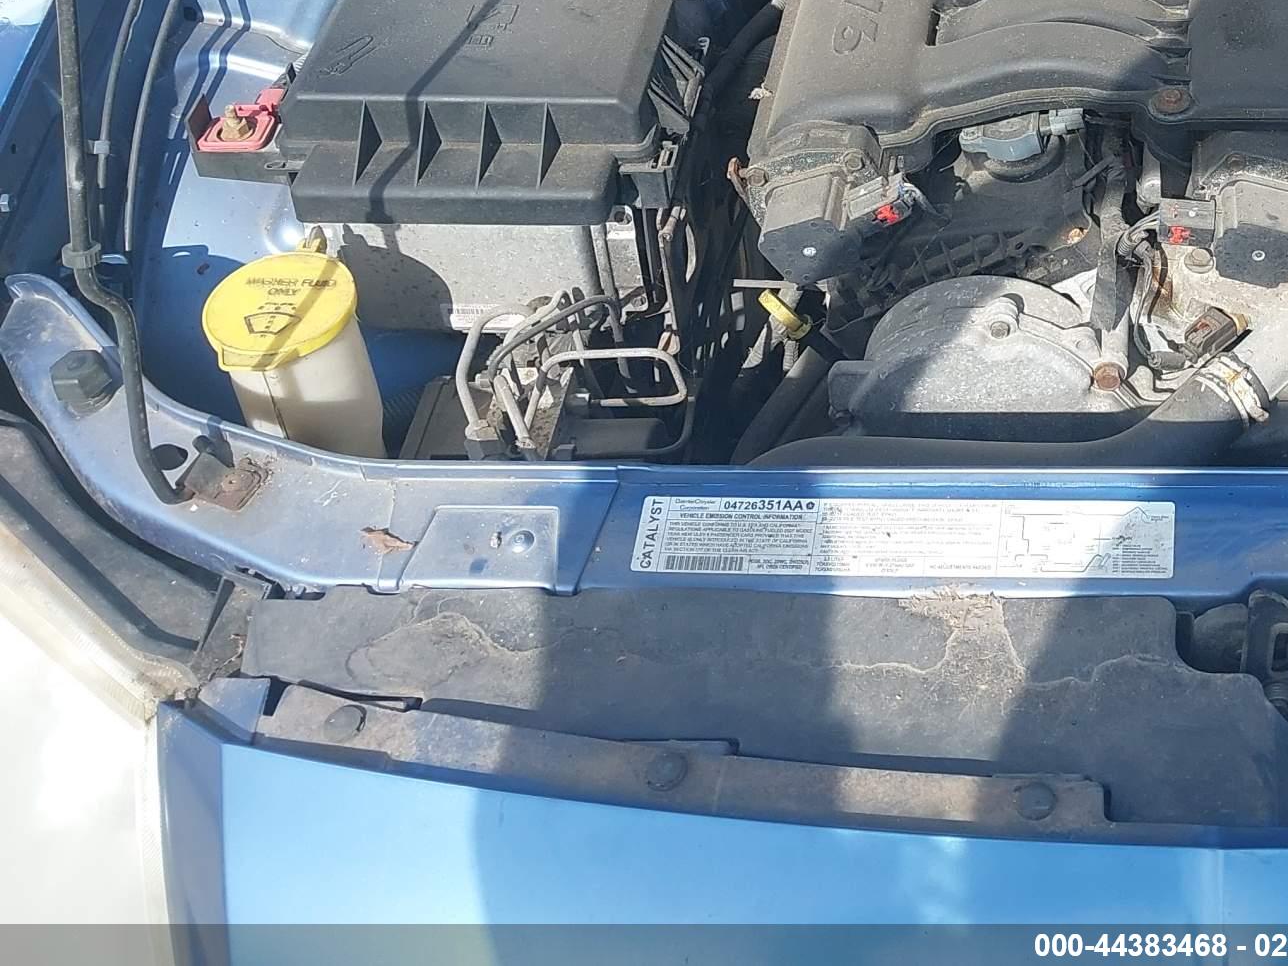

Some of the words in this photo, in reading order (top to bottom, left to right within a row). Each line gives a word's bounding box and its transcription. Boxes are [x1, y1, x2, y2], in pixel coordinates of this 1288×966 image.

[245, 276, 299, 288] WASHER
[301, 278, 337, 289] FLUID
[267, 287, 299, 296] ONLY
[724, 500, 804, 511] 04726351AA
[639, 498, 665, 570] CATALYST
